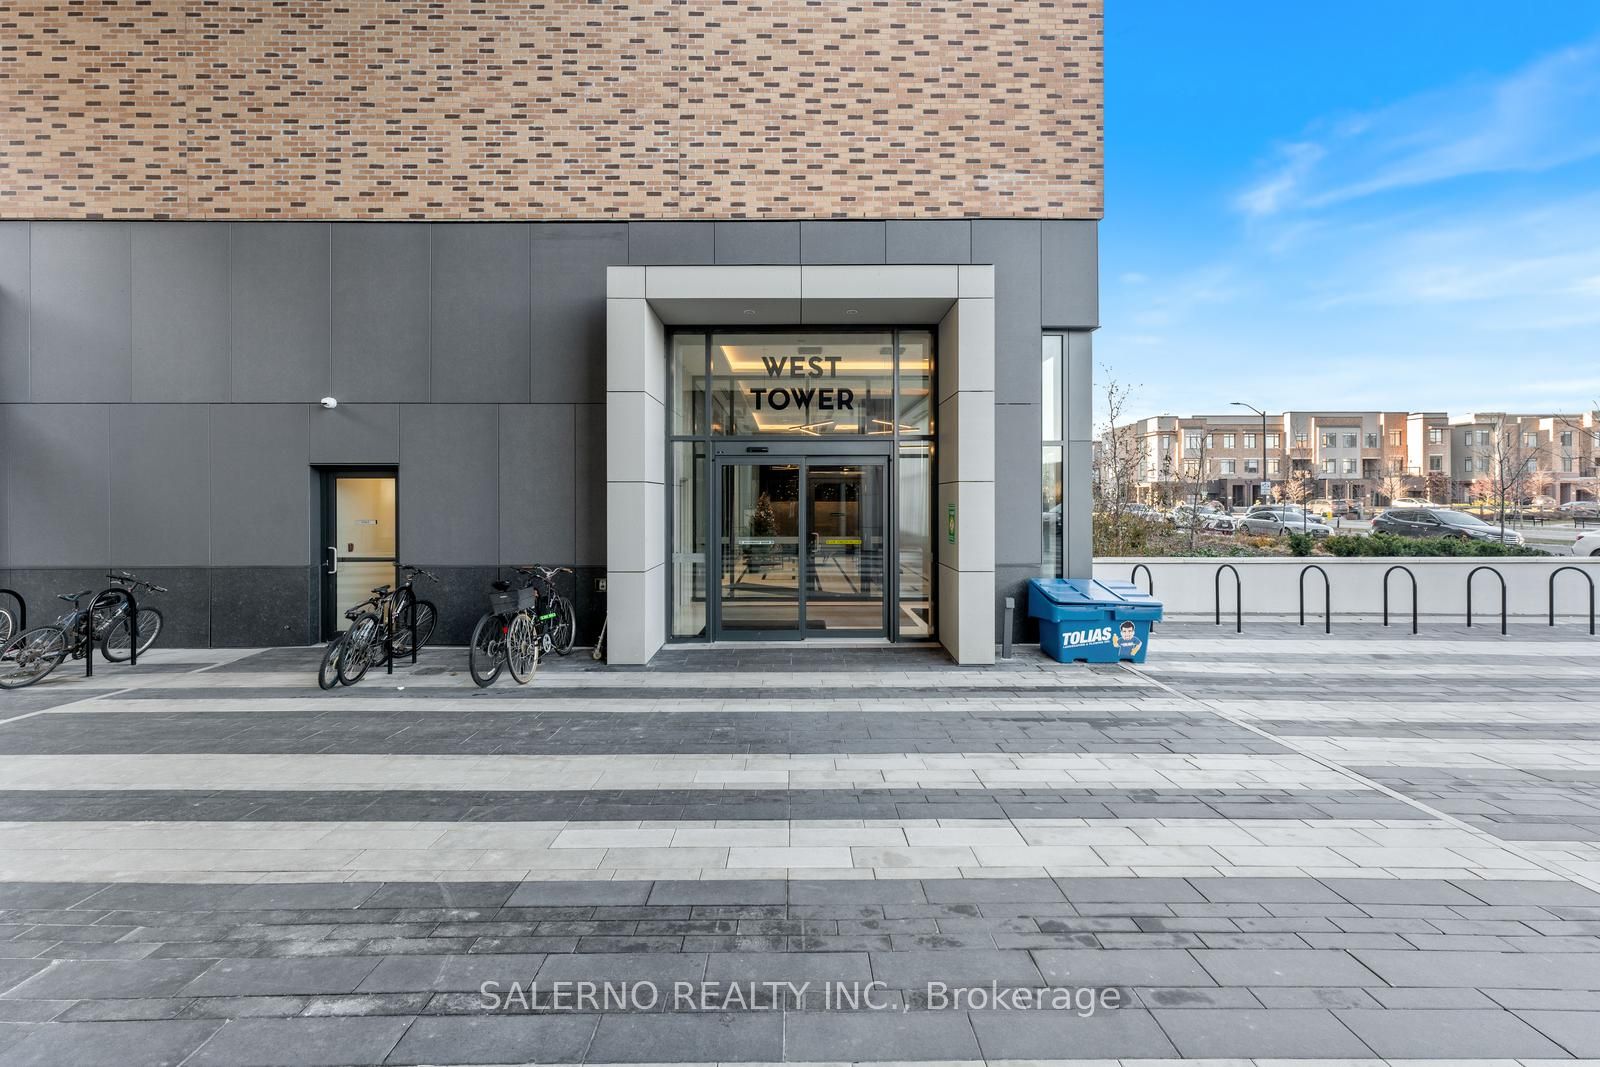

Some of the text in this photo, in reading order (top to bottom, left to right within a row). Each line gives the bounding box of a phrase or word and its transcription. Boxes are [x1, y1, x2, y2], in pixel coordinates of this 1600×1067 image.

[761, 356, 842, 379] WEST
[750, 387, 854, 411] TOWER
[1062, 627, 1112, 646] TOLIAS
